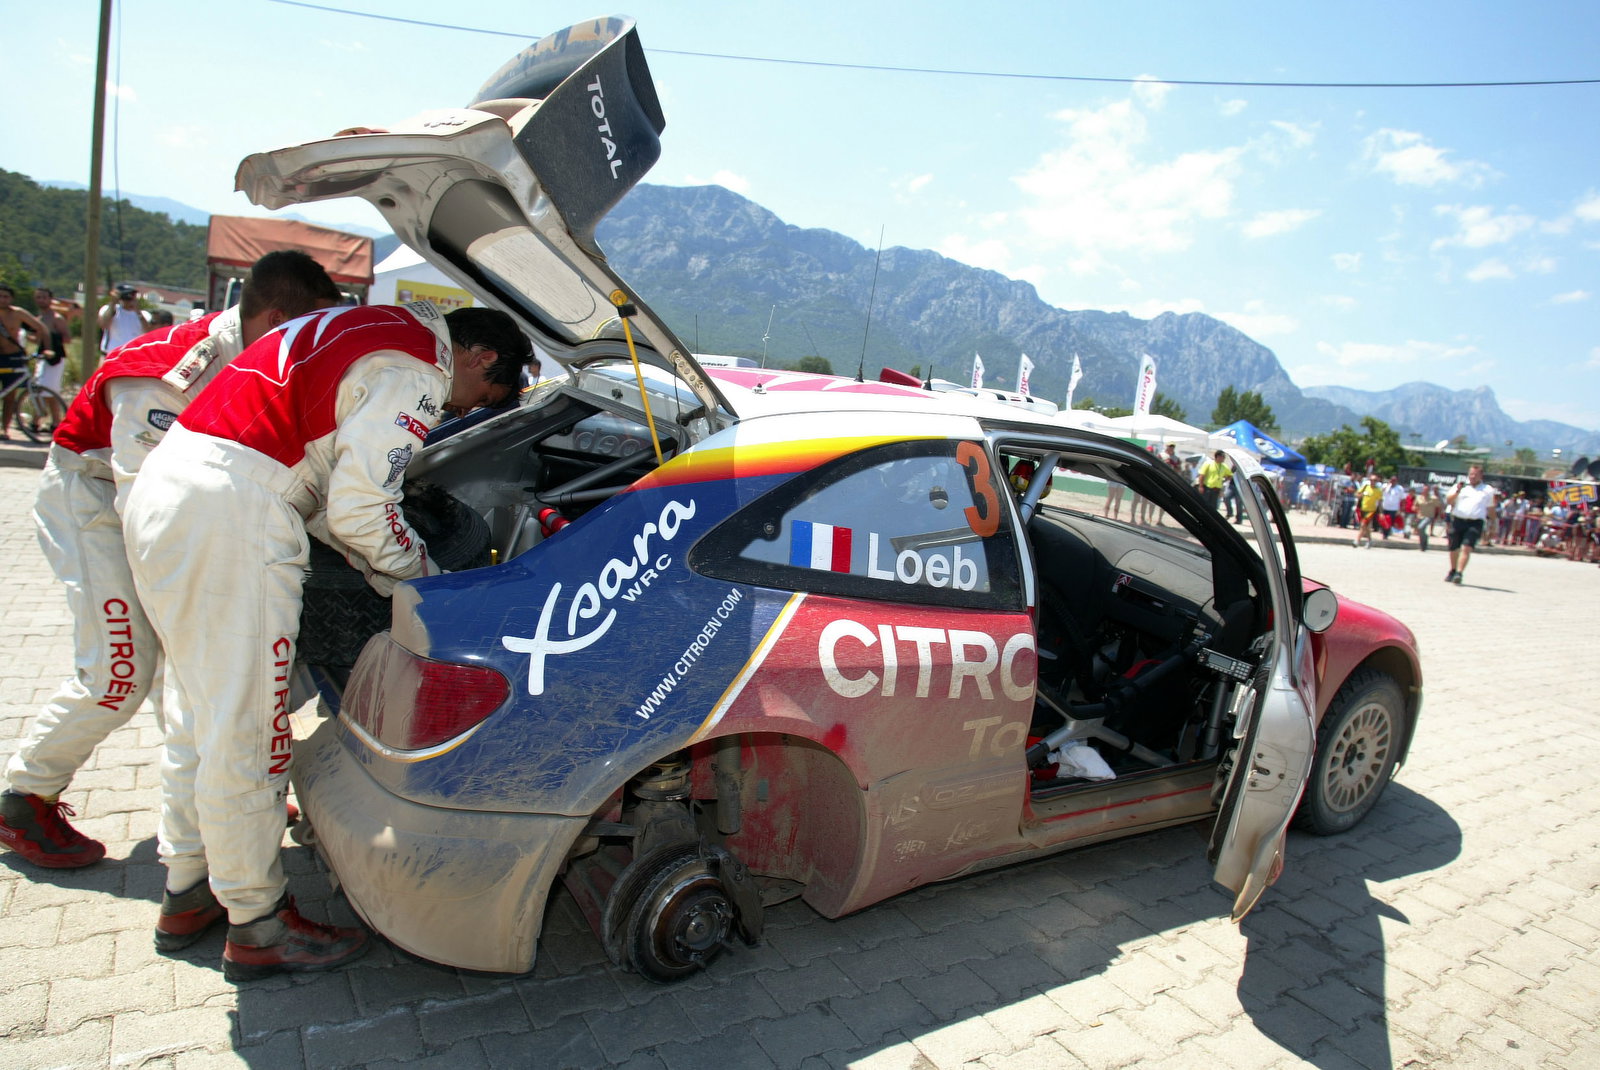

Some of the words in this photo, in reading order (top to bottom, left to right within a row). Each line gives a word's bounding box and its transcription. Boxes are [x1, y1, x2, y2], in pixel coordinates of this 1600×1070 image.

[587, 74, 622, 180] TOTAL
[956, 441, 1000, 537] 3
[502, 499, 696, 696] Xsara
[621, 553, 672, 602] WRC
[867, 532, 978, 591] Loeb
[97, 598, 137, 711] CITROËN
